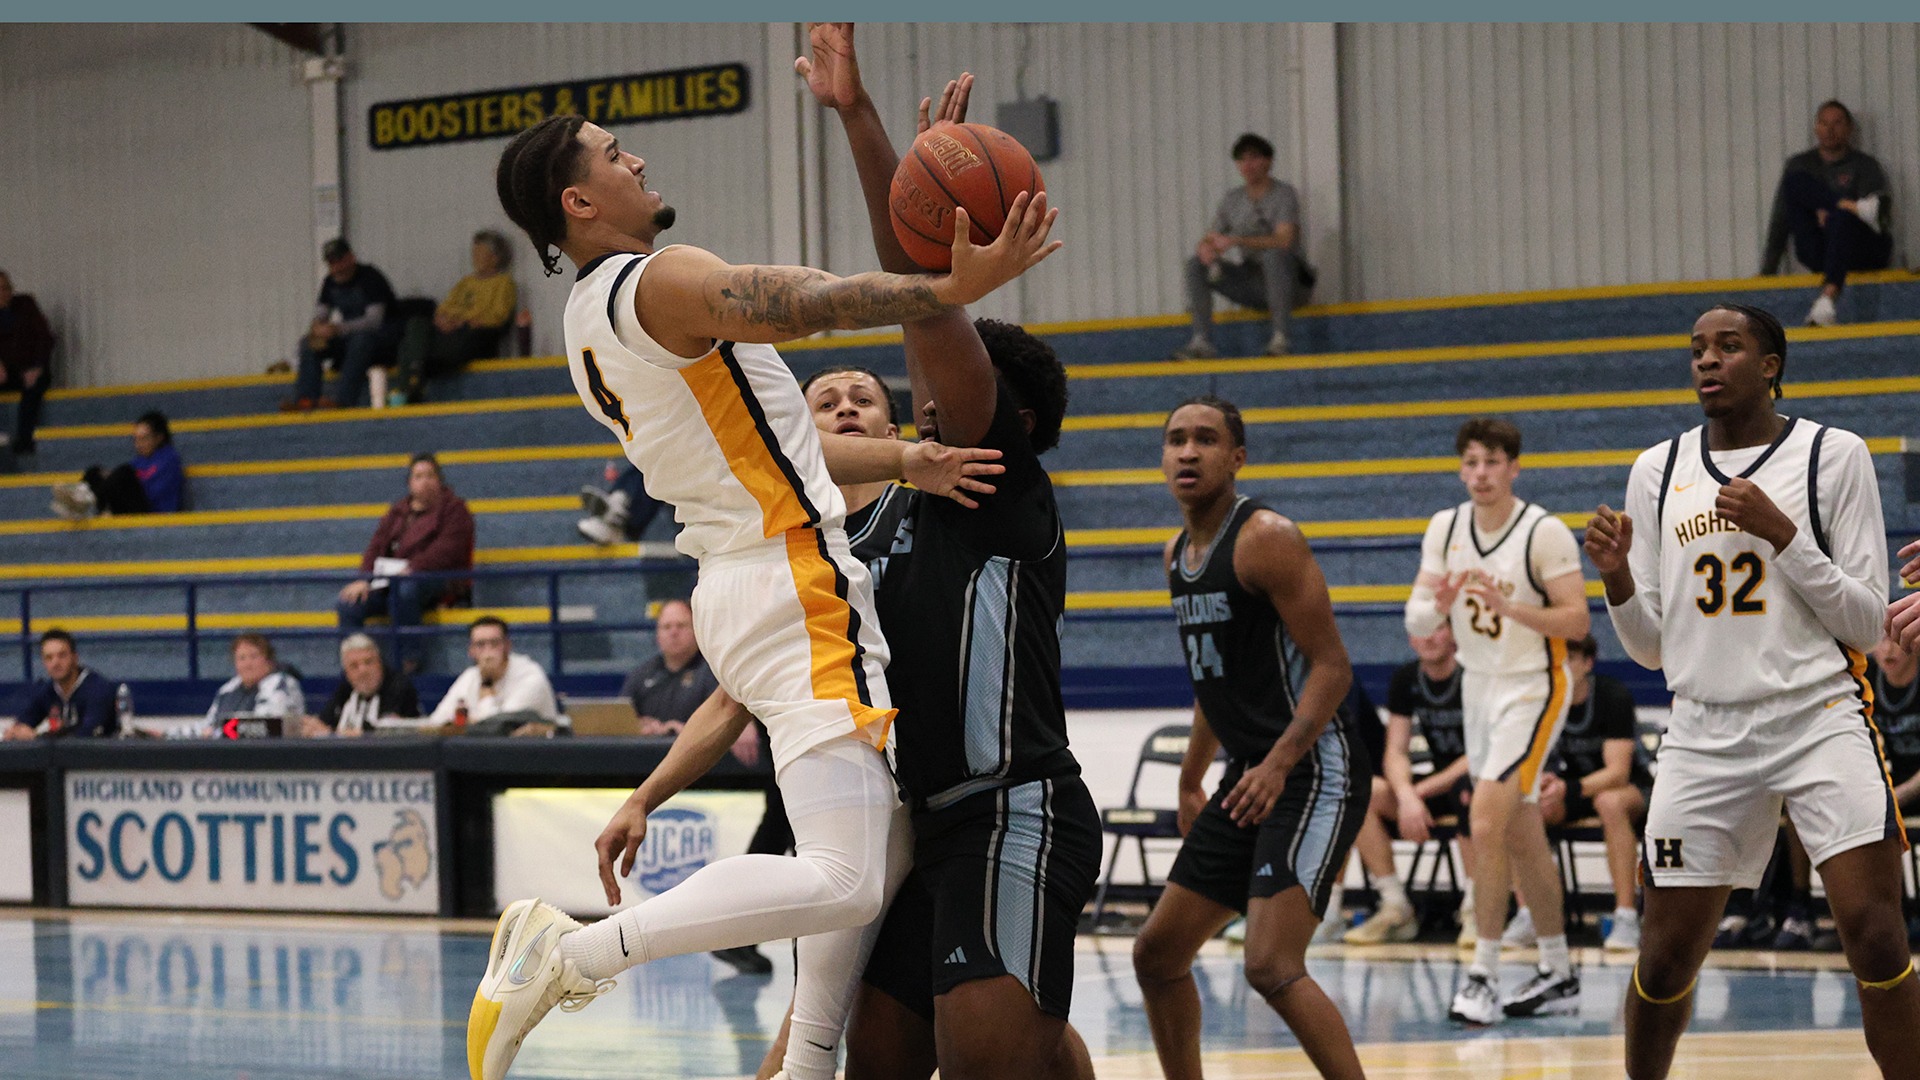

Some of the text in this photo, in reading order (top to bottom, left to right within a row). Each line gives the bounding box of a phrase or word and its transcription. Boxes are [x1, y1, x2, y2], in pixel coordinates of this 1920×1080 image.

[375, 69, 741, 144] BOOSTERS & FAMILIES
[581, 346, 633, 442] 4
[1674, 509, 1746, 548] HIGHL
[1693, 551, 1767, 618] 32
[1465, 597, 1503, 641] 23
[1187, 632, 1224, 681] 24
[73, 779, 433, 803] HIGHLAND COMMUNITY COLLEGE
[76, 810, 359, 887] SCOTTIES
[1653, 837, 1685, 869] H
